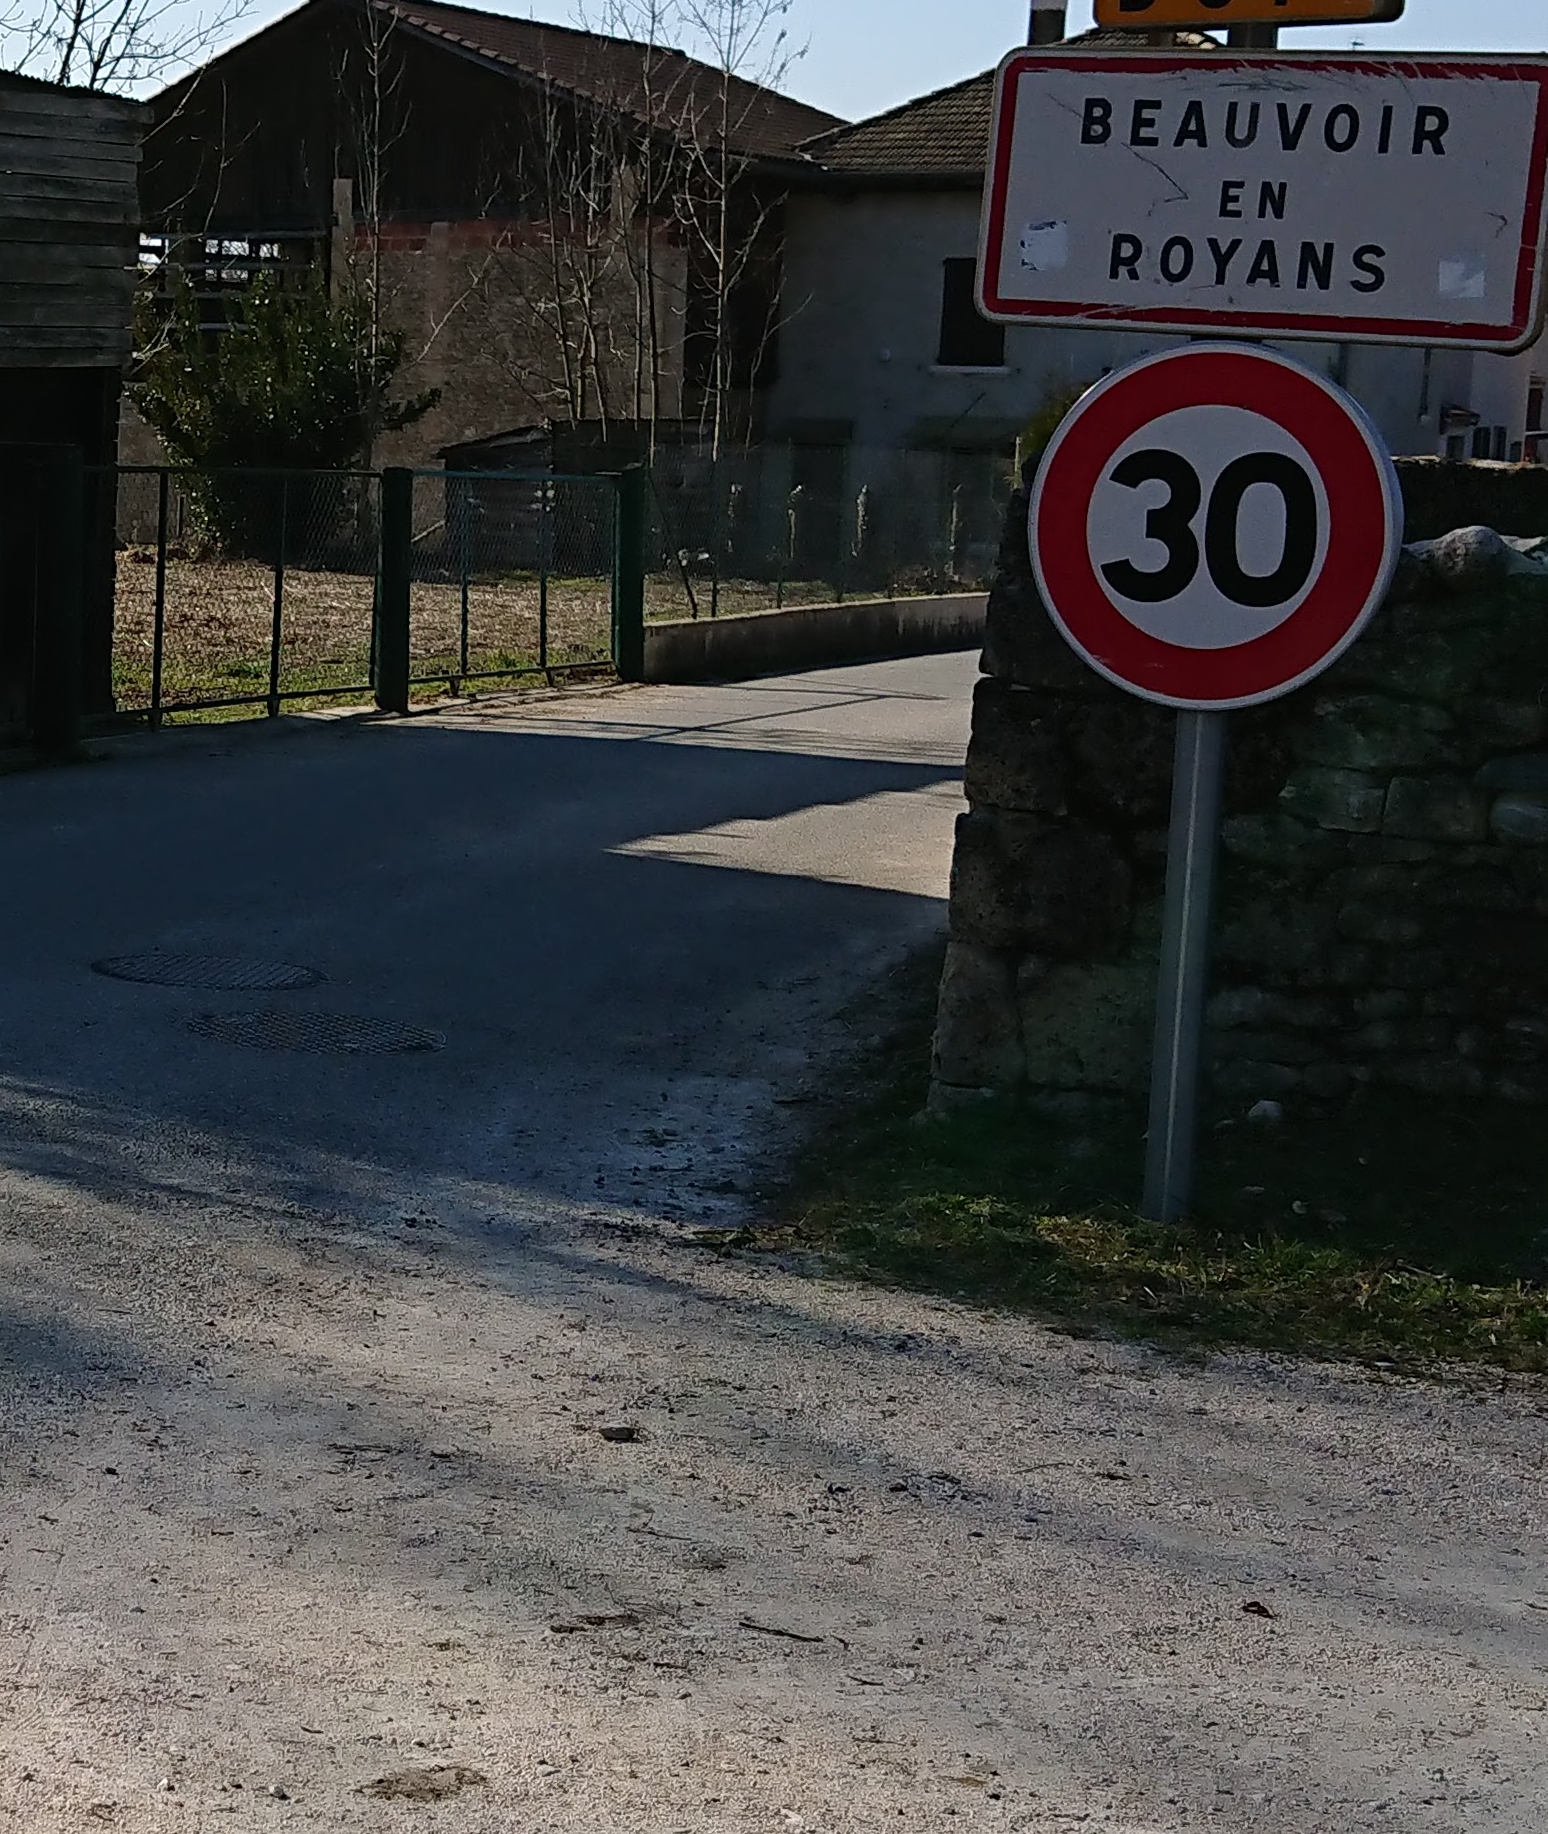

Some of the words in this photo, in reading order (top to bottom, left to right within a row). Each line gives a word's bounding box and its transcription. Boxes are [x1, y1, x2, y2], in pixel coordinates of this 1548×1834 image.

[1079, 97, 1451, 156] BEAUVOIR
[1218, 180, 1288, 219] EN
[1108, 233, 1386, 293] ROYANS
[1099, 447, 1319, 608] 30
